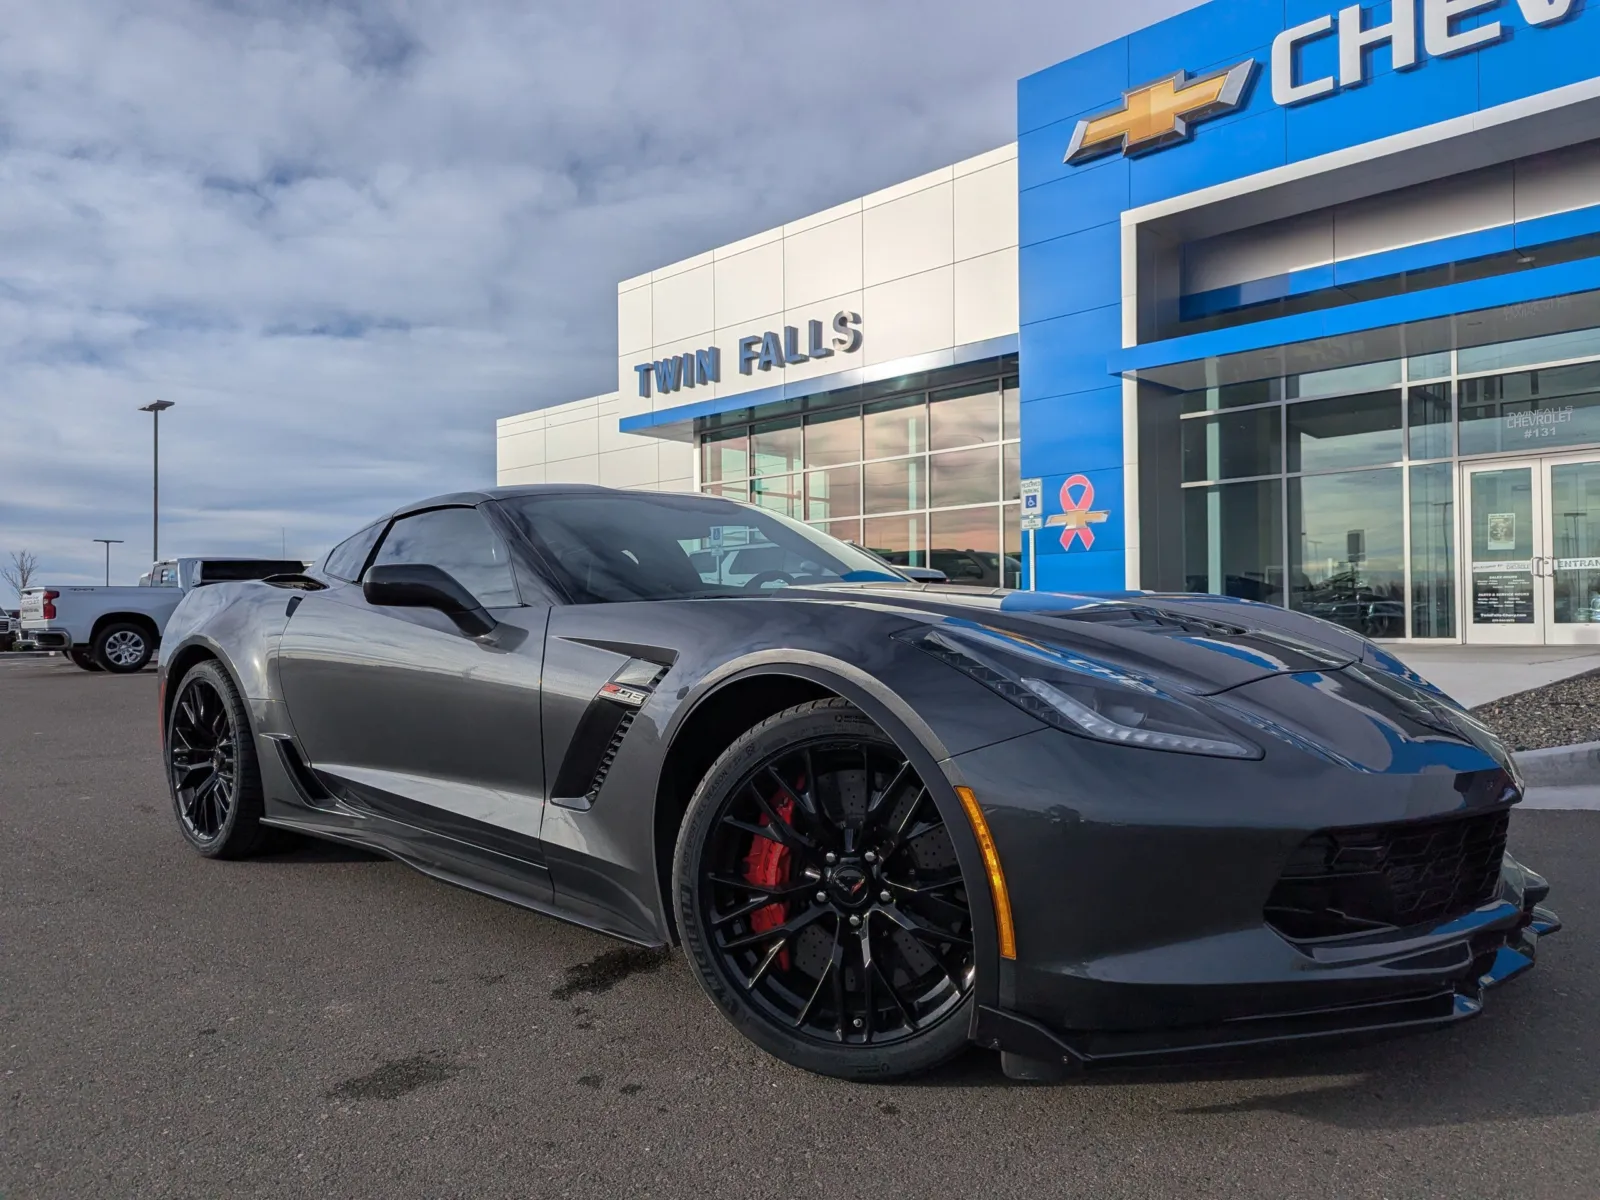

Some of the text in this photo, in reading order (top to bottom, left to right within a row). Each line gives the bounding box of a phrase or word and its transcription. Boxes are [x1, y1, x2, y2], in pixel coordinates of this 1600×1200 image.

[634, 310, 863, 398] TWIN FALLS
[1507, 411, 1573, 428] CHEVROLET
[1524, 426, 1556, 438] #131
[681, 887, 724, 990] MICHELIN
